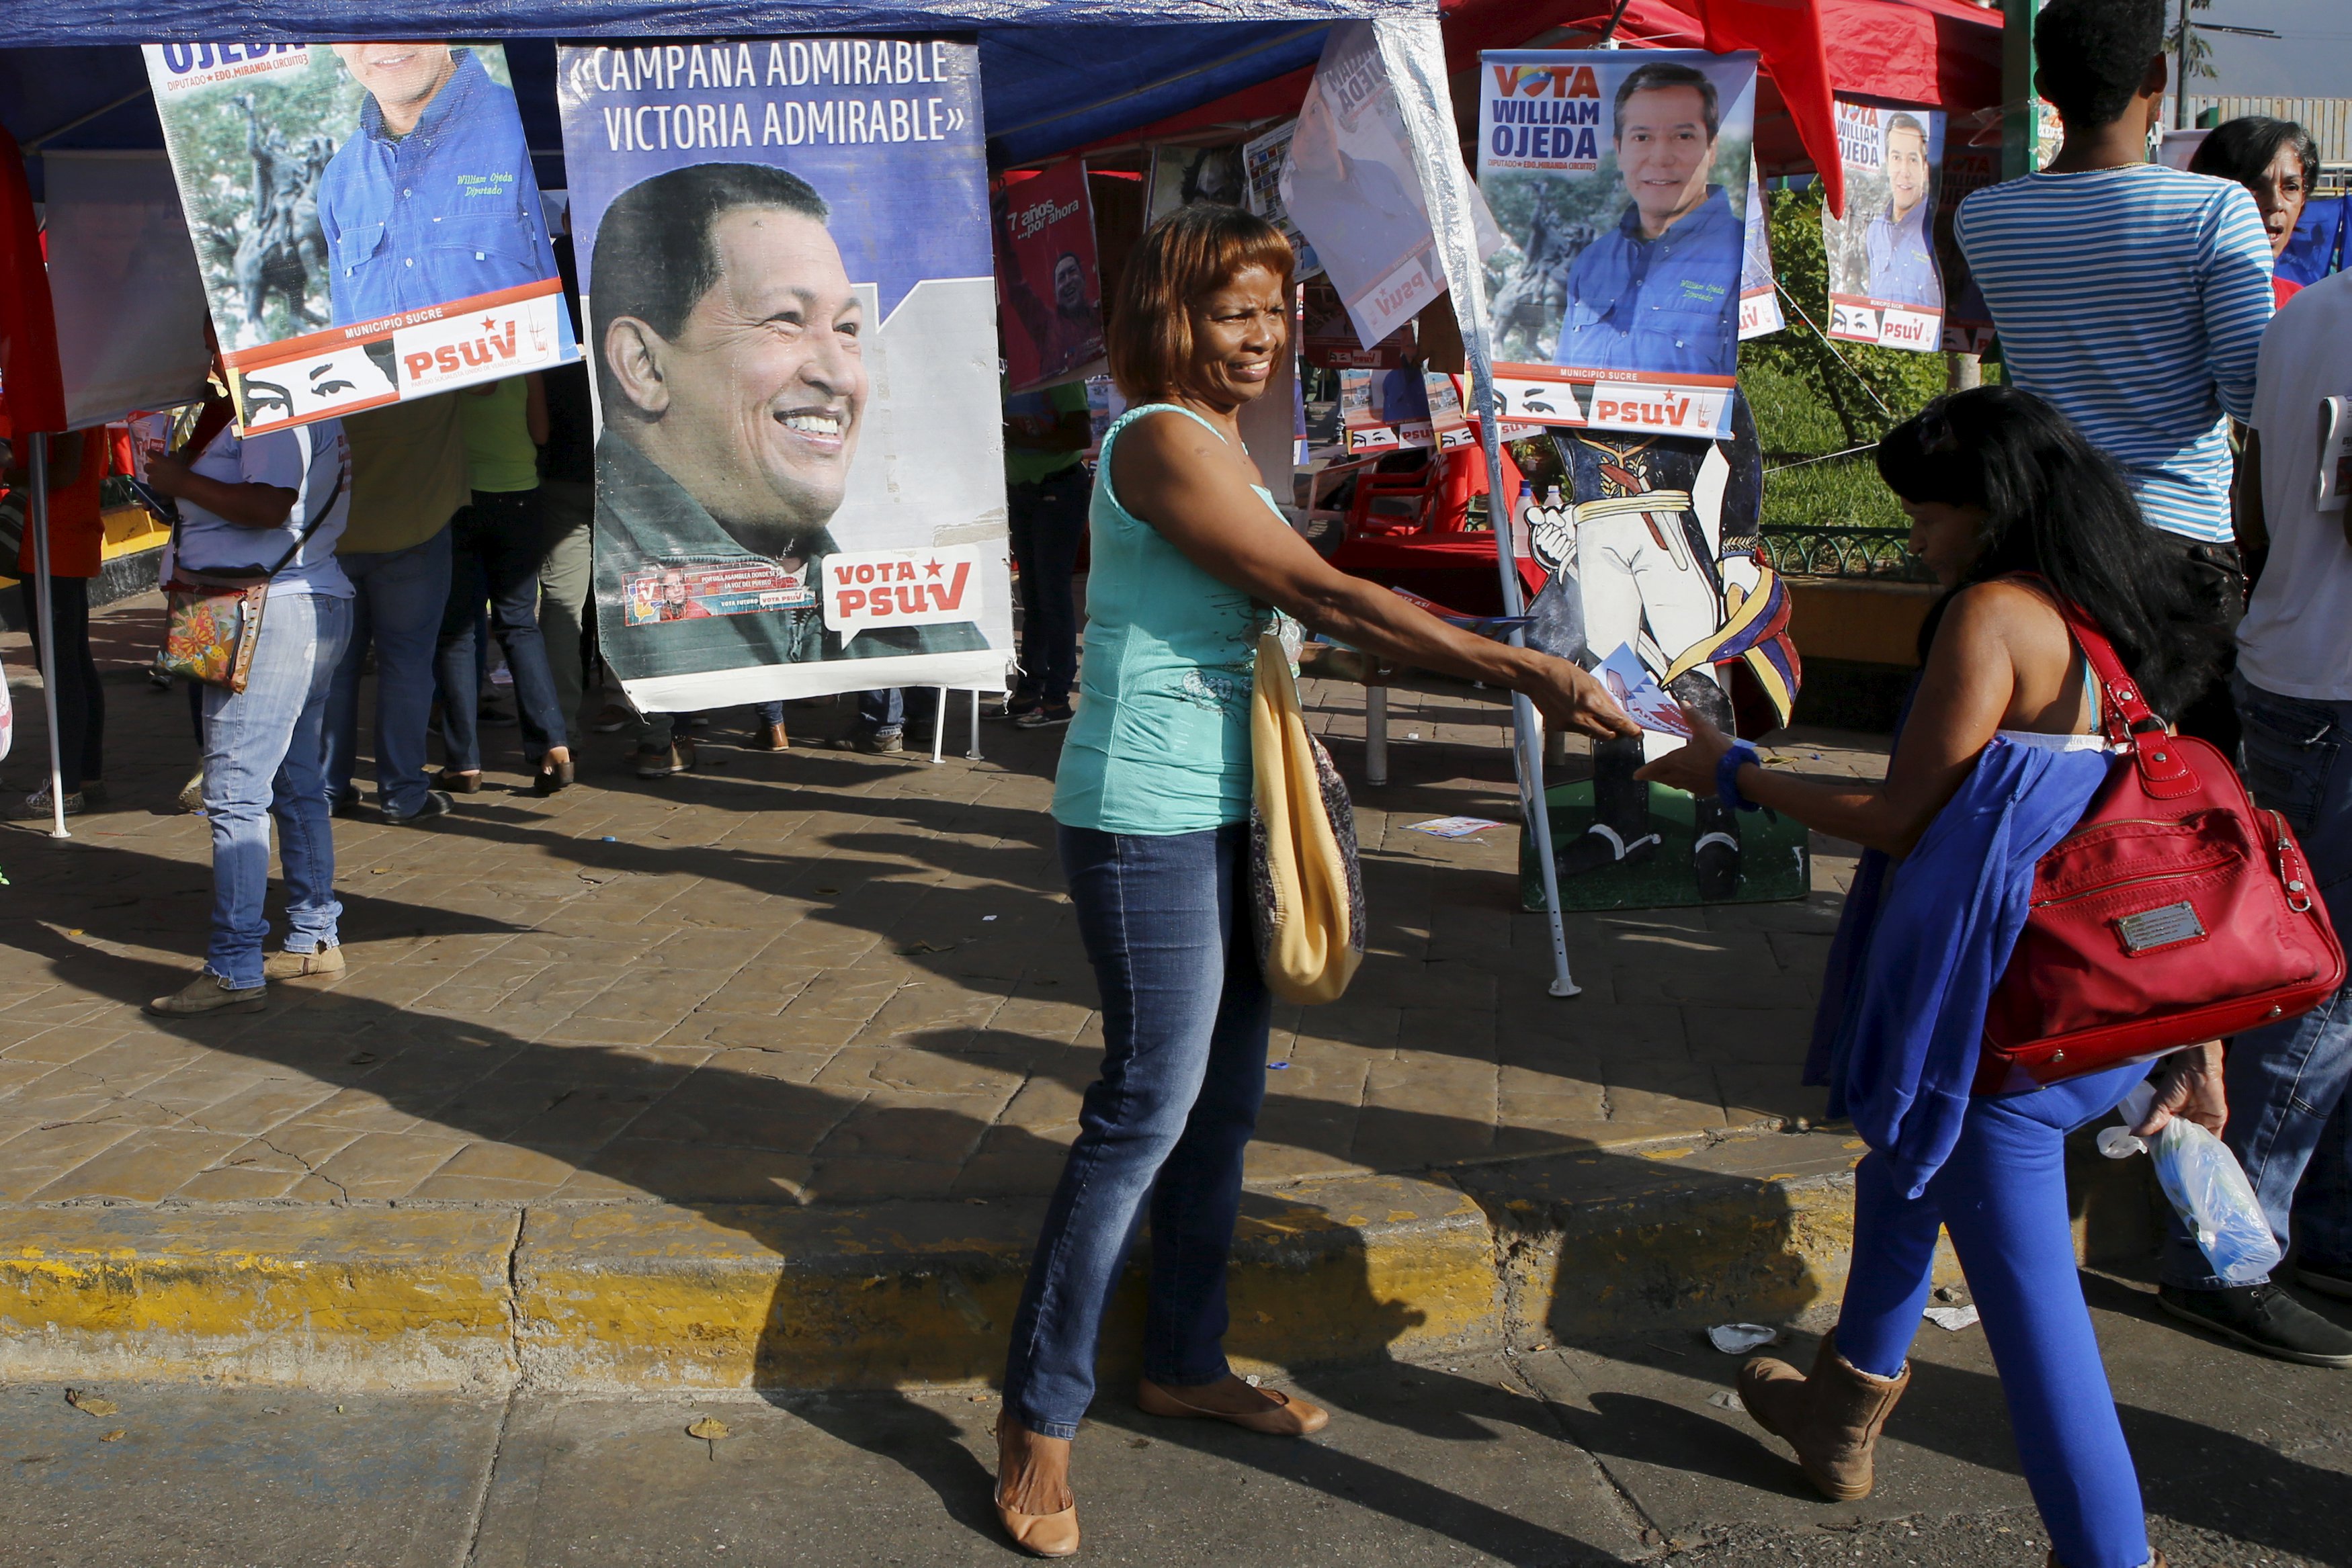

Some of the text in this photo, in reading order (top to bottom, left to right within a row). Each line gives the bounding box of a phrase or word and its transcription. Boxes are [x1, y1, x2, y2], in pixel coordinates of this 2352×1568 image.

[163, 44, 306, 74] OJE
[766, 40, 949, 87] ADMIRABLE
[167, 74, 206, 91] DIPUTADO
[215, 60, 273, 82] EDO.MIRANDA
[1493, 100, 1599, 125] WILLIAM
[604, 103, 753, 151] VICTORIA
[1838, 120, 1879, 145] WILLIAM
[1492, 125, 1597, 159] OJEDA
[1838, 138, 1880, 167] OJEDA
[1488, 159, 1517, 168] DIPUTADO
[458, 171, 513, 185] William Ojeda
[465, 184, 503, 198] Diputado
[1007, 199, 1054, 231] 7 años
[1048, 200, 1079, 224] ahora
[345, 307, 444, 339] MUNICIPIO SUCRE
[411, 378, 434, 388] PARTIDO
[434, 372, 464, 384] SOCIALISTA
[465, 367, 483, 376] UNIDO
[491, 358, 521, 370] VENEZUELA
[1560, 369, 1638, 381] MUNICIPIO SUCRE
[1402, 427, 1435, 440] PSU
[724, 572, 751, 581] ASAMBLEA
[834, 562, 915, 585] VOTA
